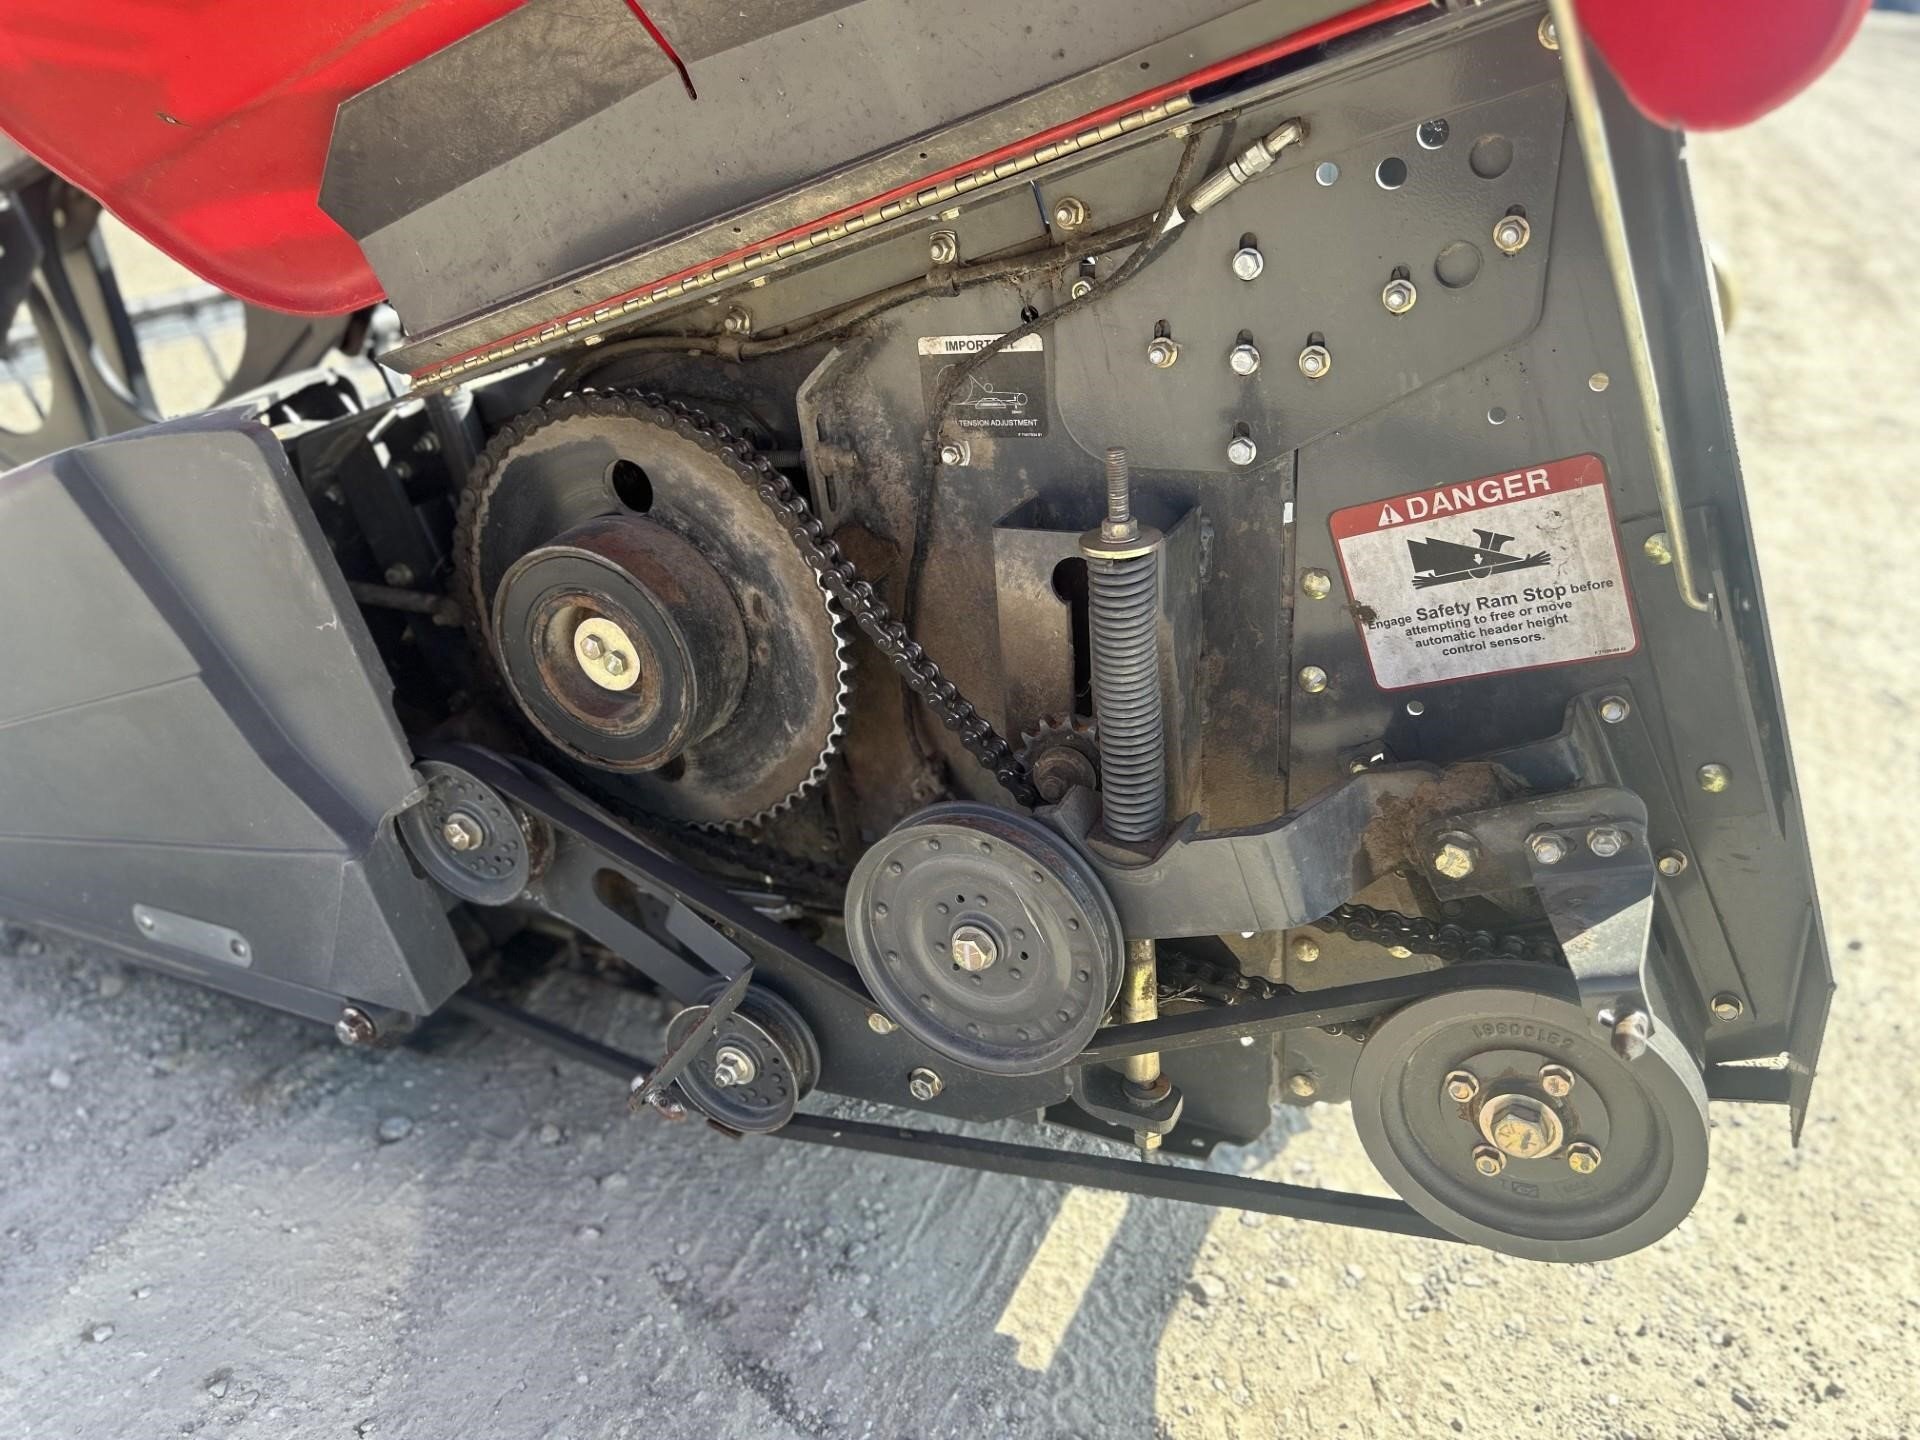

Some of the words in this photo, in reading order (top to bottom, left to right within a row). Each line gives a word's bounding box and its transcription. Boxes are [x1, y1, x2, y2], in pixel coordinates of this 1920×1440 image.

[990, 419, 1038, 427] ADJUSTMENT
[1406, 468, 1551, 520] DANGER
[1368, 615, 1412, 630] Engage
[1416, 602, 1471, 621] Safety
[1476, 594, 1518, 611] Ram
[1523, 585, 1567, 602] Stop
[1570, 579, 1614, 594] before
[1405, 618, 1471, 637] attempting
[1473, 614, 1487, 624] to
[1490, 610, 1515, 622] free
[1519, 606, 1533, 616] or
[1536, 600, 1573, 614] move
[1415, 629, 1476, 648] automatic
[1479, 622, 1523, 637] header
[1526, 613, 1569, 630] height
[1442, 641, 1486, 656] control
[1489, 633, 1546, 648] sensors.
